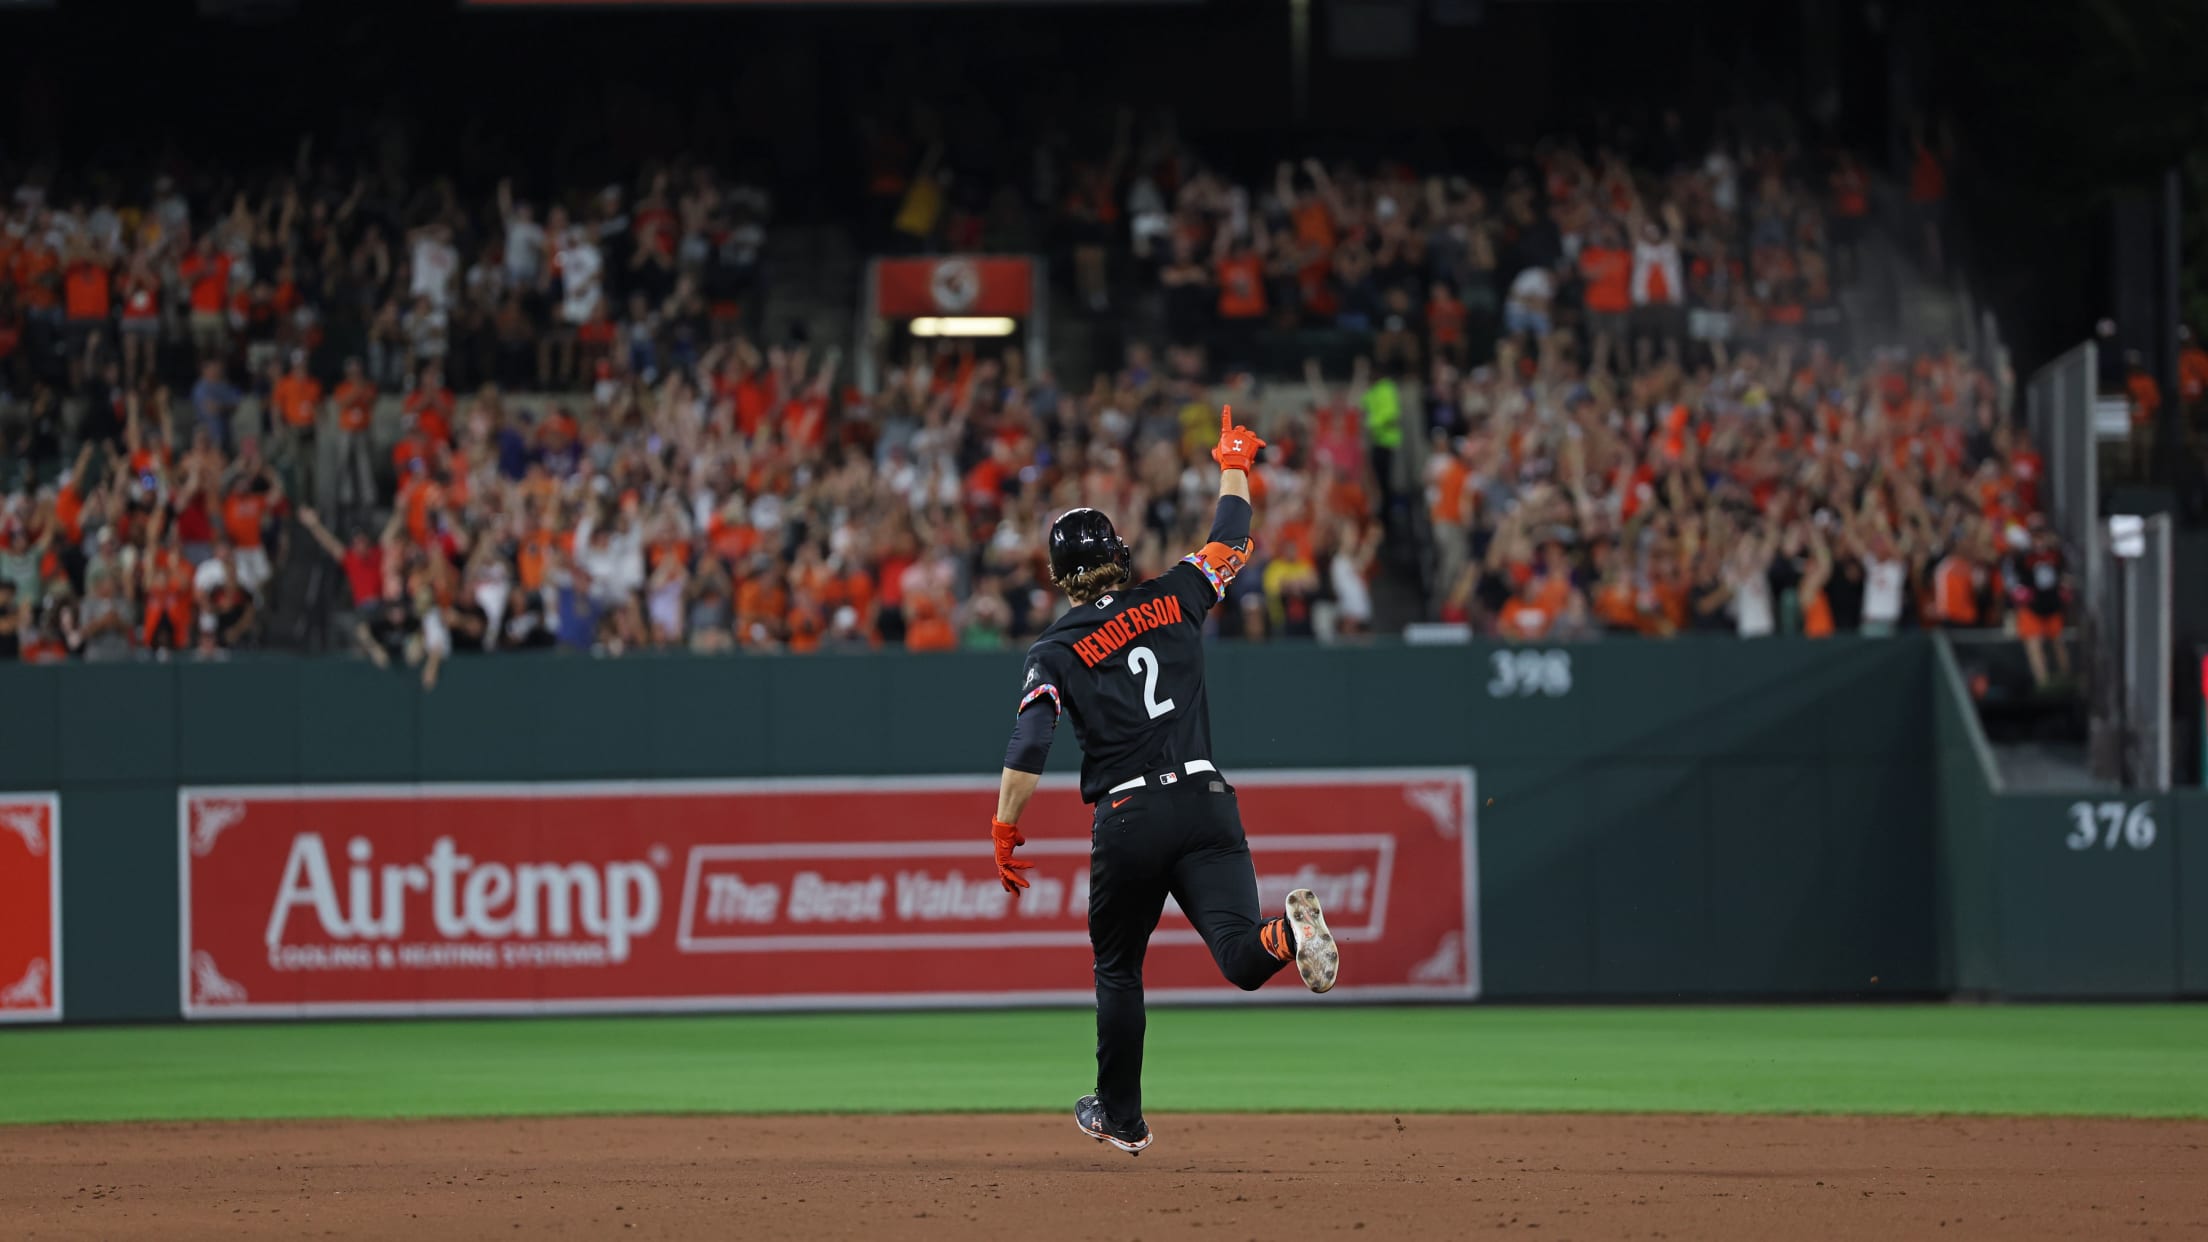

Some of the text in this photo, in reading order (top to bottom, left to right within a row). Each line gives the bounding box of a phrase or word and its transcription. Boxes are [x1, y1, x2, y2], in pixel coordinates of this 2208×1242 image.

[1072, 595, 1183, 669] HENDERSON
[1127, 646, 1176, 720] 2
[1487, 649, 1572, 698] 398
[2065, 801, 2156, 851] 376
[265, 832, 661, 962] Airtemp
[705, 873, 779, 923] The
[787, 870, 886, 923] Best
[895, 869, 1011, 920] Value
